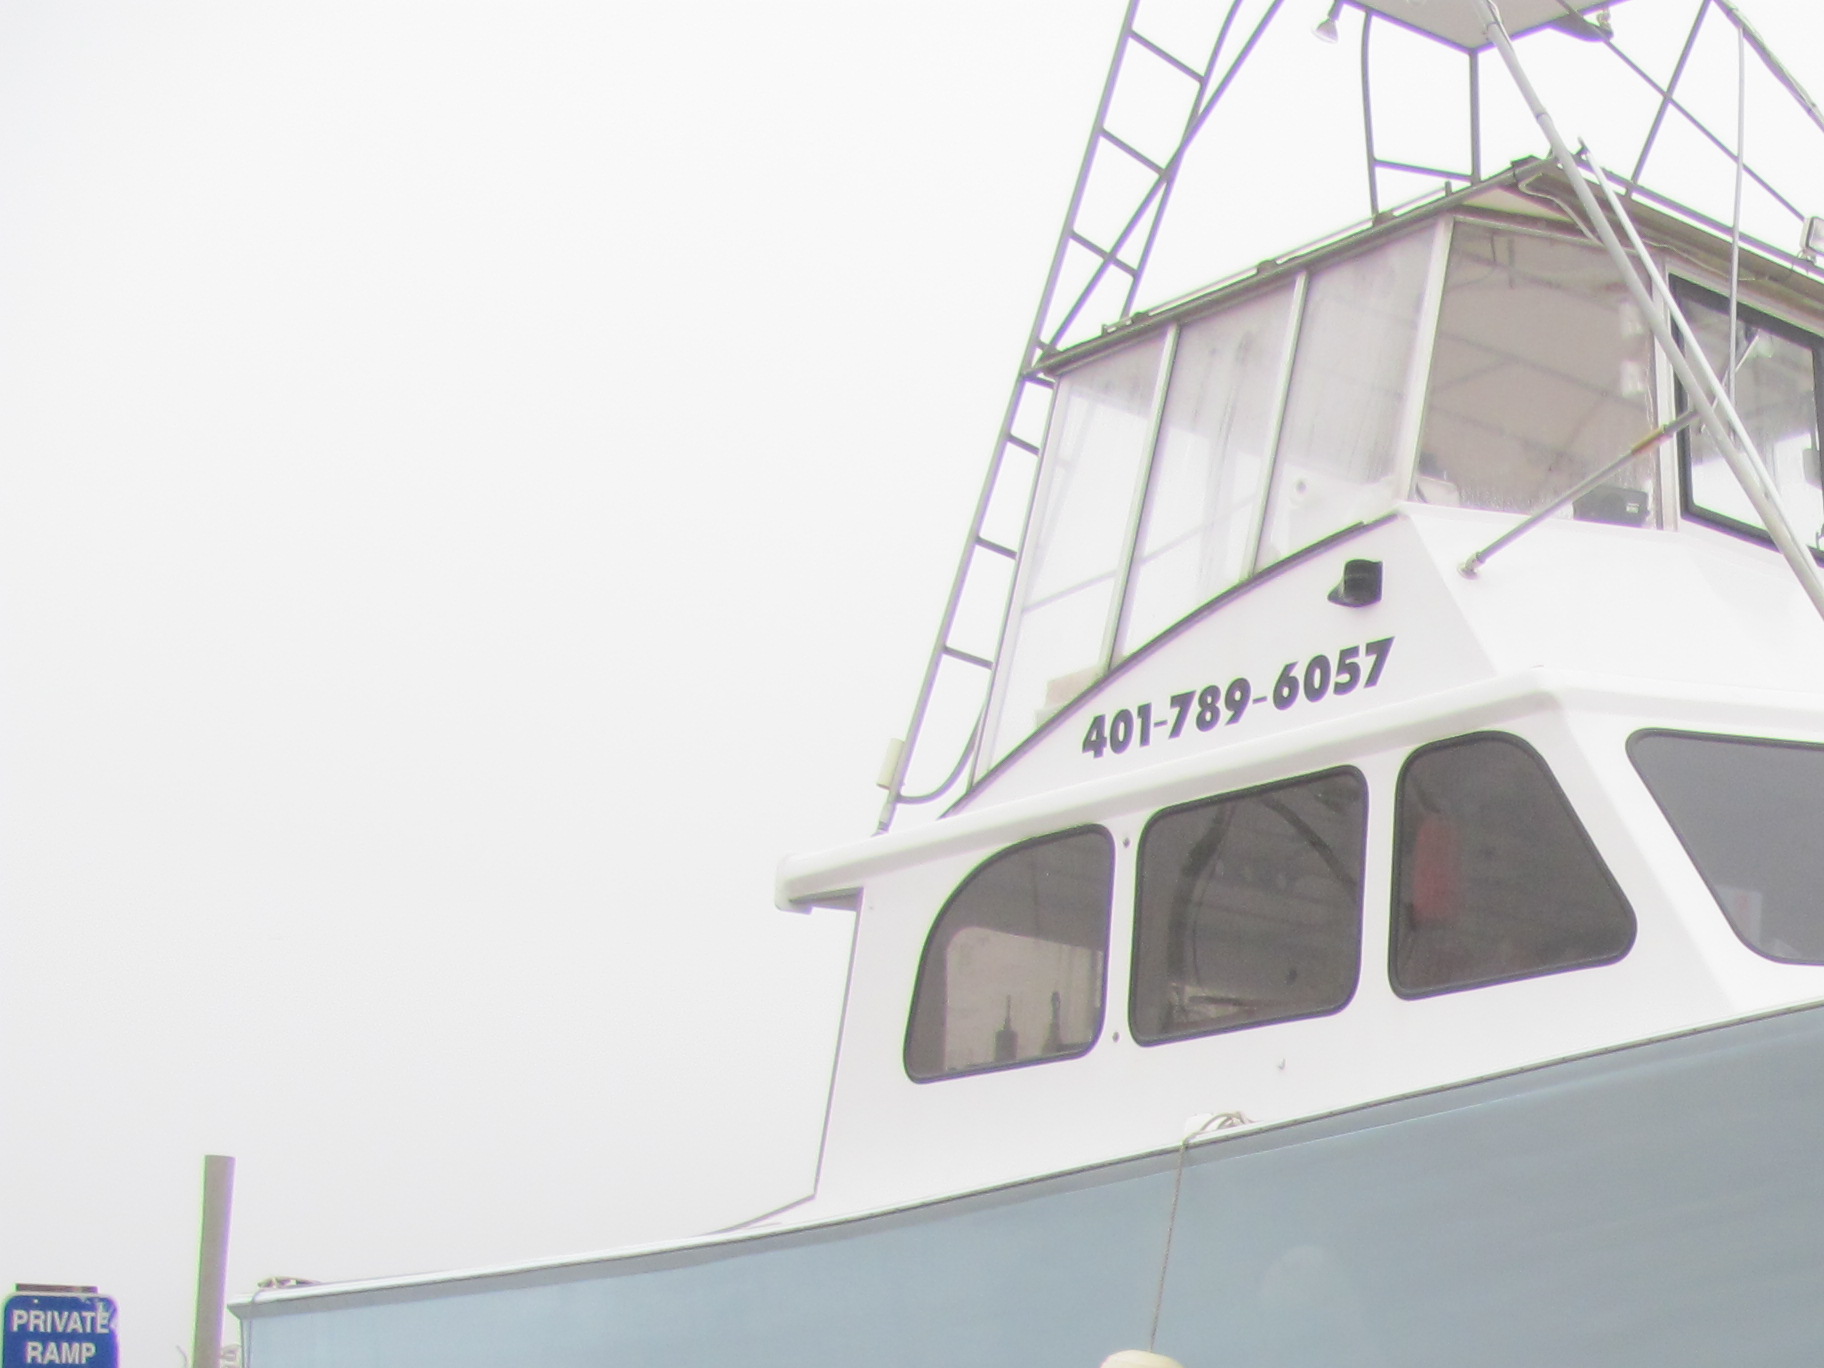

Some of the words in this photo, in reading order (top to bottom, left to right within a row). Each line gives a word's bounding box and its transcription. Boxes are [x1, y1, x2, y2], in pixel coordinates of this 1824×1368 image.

[1081, 635, 1396, 759] 401-789-6057
[10, 1309, 110, 1334] PRIVATE
[26, 1341, 97, 1365] RAMP
